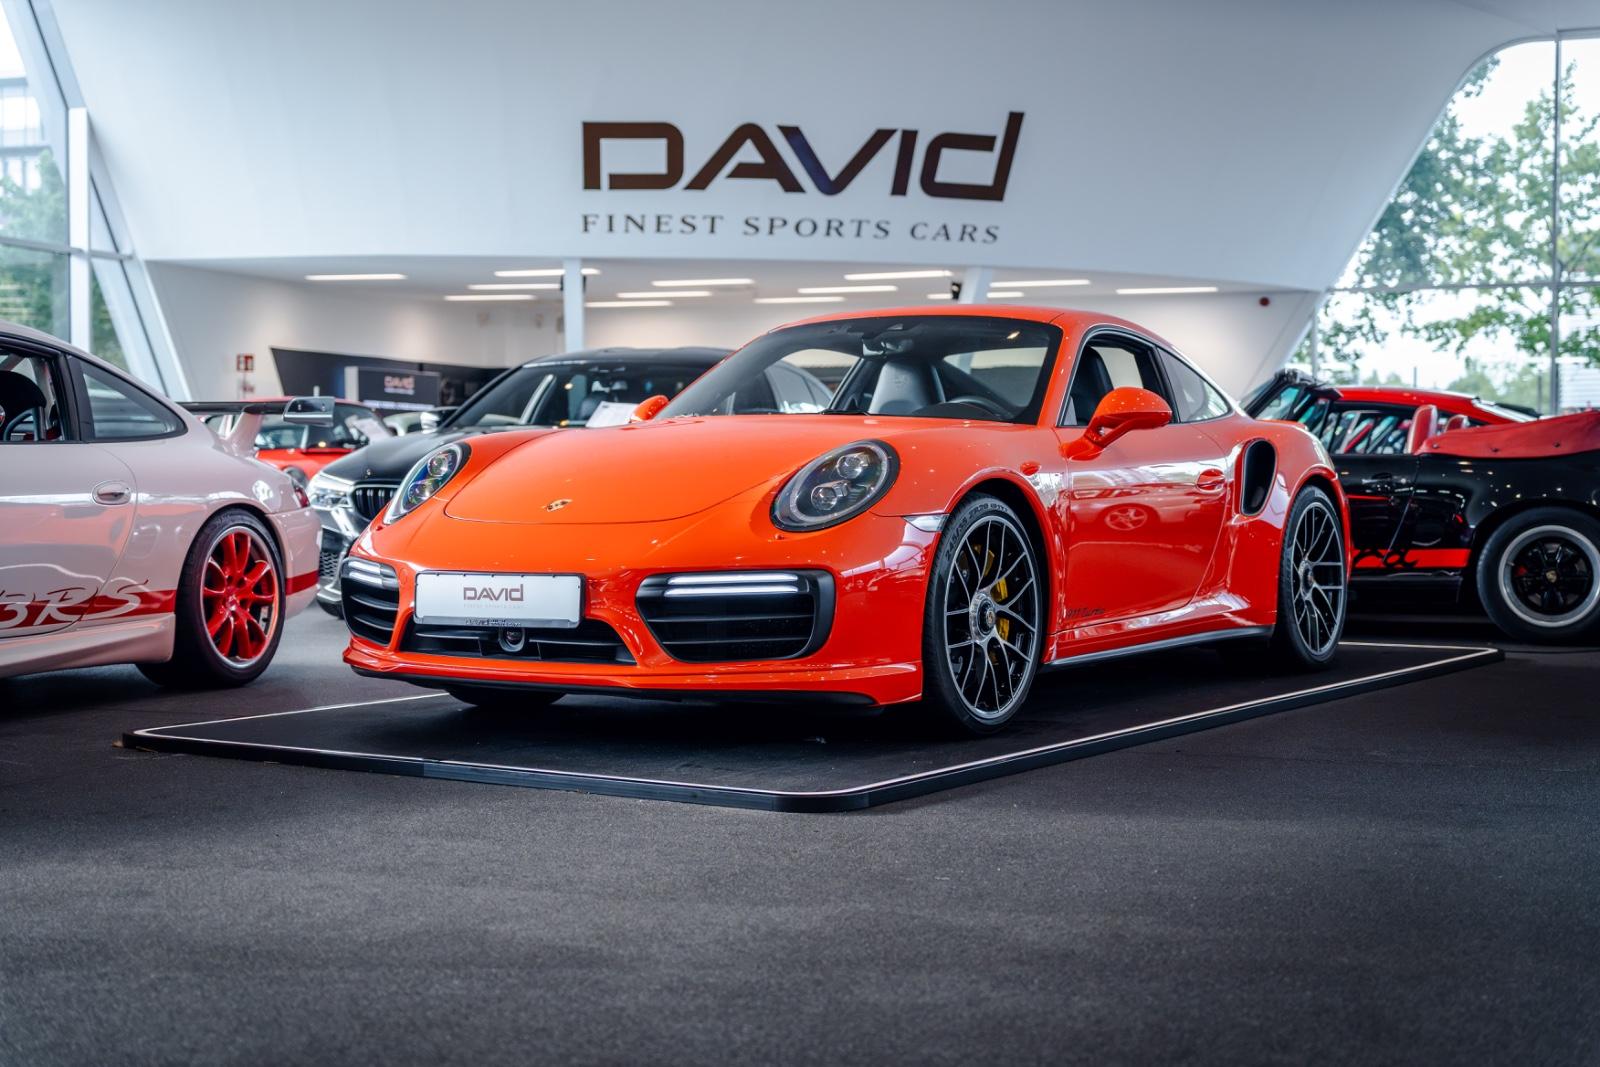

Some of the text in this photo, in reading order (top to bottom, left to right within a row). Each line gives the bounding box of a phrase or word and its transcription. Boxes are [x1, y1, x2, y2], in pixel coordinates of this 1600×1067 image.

[581, 214, 1001, 244] FINEST SPORTS CARS
[0, 579, 149, 629] 3RS
